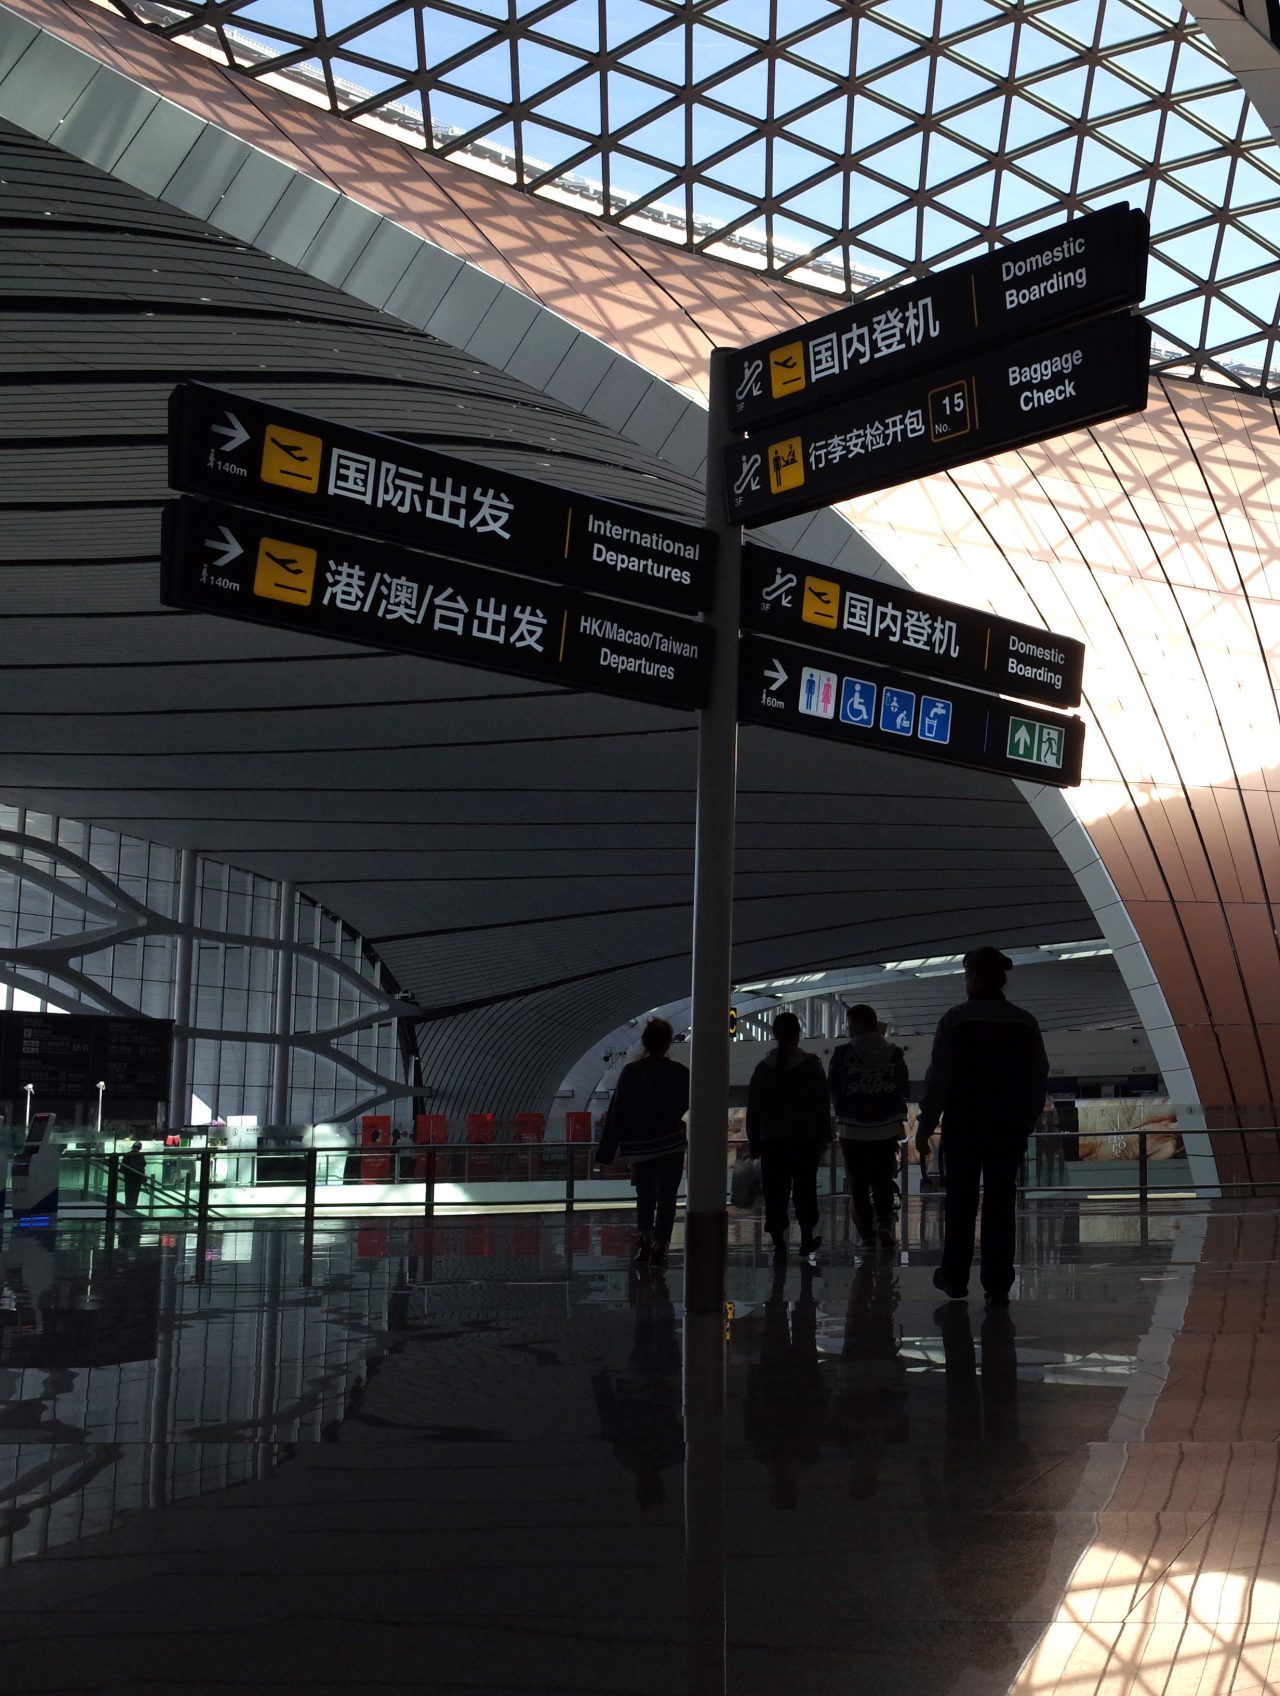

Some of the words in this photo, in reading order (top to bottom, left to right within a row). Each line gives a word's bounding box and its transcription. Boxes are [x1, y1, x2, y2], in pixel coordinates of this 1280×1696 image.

[1001, 235, 1086, 282] Domestic
[1003, 265, 1087, 310] Boarding
[808, 296, 940, 383] 国内登机
[1007, 348, 1083, 387] Baggage
[941, 392, 965, 415] 15
[1019, 378, 1076, 411] Check
[808, 408, 925, 471] 行李安检开包
[934, 421, 951, 435] No.
[216, 461, 247, 477] 140m
[327, 446, 514, 540] 国际出发
[587, 514, 700, 561] International
[209, 575, 240, 592] 140m
[592, 542, 692, 586] Departures
[321, 558, 548, 653] 港/澳/台出发
[760, 602, 771, 612] 3F
[842, 591, 959, 658] 国内登机
[579, 615, 699, 659] HK/Macao/Taiwan
[1008, 635, 1065, 665] Domestic
[599, 647, 675, 680] Departures
[1007, 658, 1063, 690] Boarding
[766, 697, 785, 709] 60m
